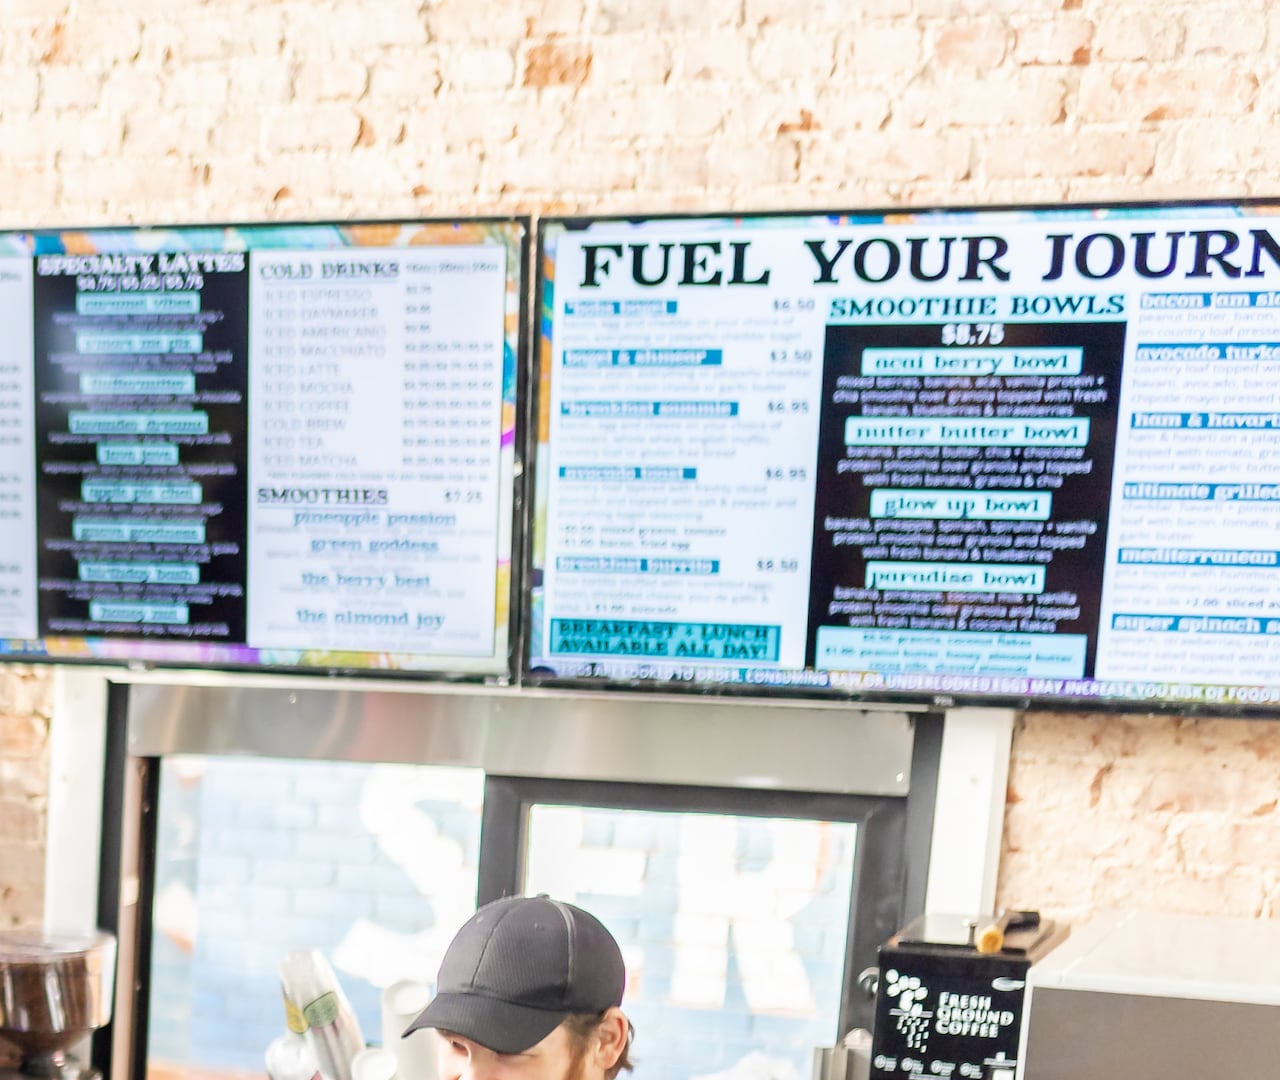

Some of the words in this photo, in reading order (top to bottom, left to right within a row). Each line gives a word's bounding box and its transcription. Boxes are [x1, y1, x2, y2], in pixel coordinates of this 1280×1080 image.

[38, 255, 154, 275] SPECIALTY
[158, 252, 246, 272] LATTES
[579, 241, 772, 288] FUEL
[804, 235, 1011, 284] YOUR
[1042, 229, 1280, 280] JOURN
[260, 263, 314, 280] COLD
[320, 261, 400, 279] DRINKS
[830, 294, 997, 317] SMOOTHIE
[1010, 292, 1126, 315] BOWLS
[1142, 293, 1204, 309] bacon
[1136, 344, 1222, 361] avocado
[875, 353, 924, 369] acai
[934, 352, 1003, 376] berry
[1012, 353, 1068, 369] bowl
[1135, 412, 1183, 429] ham
[940, 424, 1014, 440] butter
[1023, 424, 1079, 440] bowl
[256, 487, 389, 505] SMOOTHIES
[1123, 483, 1211, 500] ultimate
[884, 494, 937, 518] glow
[946, 498, 976, 519] up
[985, 495, 1039, 513] bowl
[293, 511, 380, 528] pineapple
[386, 512, 458, 528] passion
[310, 538, 362, 554] green
[368, 539, 440, 555] goddess
[1120, 548, 1278, 566] mediterranean
[302, 572, 331, 588] the
[336, 573, 387, 590] berry
[871, 569, 974, 592] paradise
[983, 570, 1037, 587] bowl
[296, 608, 328, 625] the
[333, 609, 409, 627] almond
[416, 611, 446, 630] joy
[1113, 615, 1175, 632] super
[1177, 616, 1262, 634] spinach
[559, 622, 676, 638] BREAKFAST
[701, 623, 769, 641] LUNCH
[558, 638, 670, 656] AVAILABLE
[674, 641, 717, 657] ALL
[721, 642, 769, 659] DAY!
[939, 990, 993, 1011] FRESH
[936, 1007, 1015, 1027] GROUND
[935, 1021, 999, 1039] COFFEE
